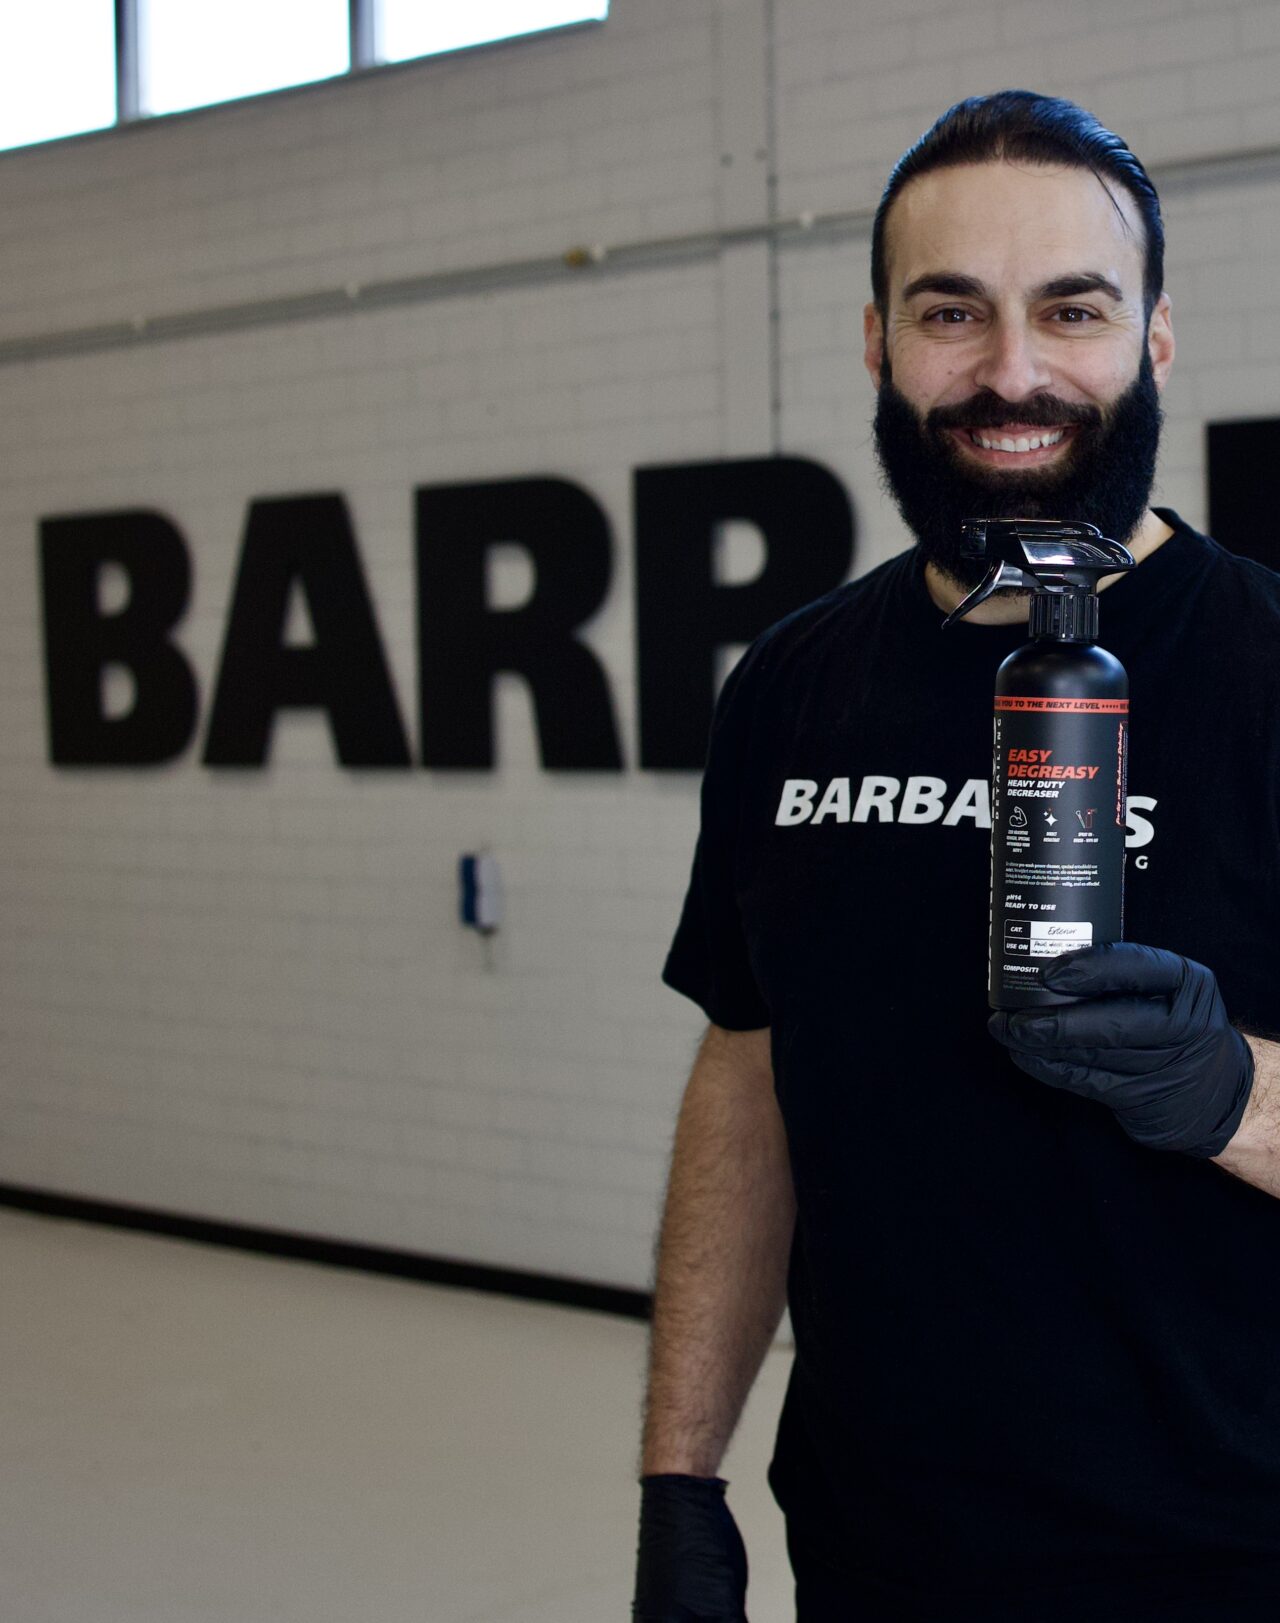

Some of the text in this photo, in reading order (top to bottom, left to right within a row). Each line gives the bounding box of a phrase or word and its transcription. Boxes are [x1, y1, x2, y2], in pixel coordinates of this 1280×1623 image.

[1008, 749, 1052, 763] EASY
[1007, 764, 1099, 779] DEGREASY
[1007, 779, 1065, 789] HEAVY DUTY
[1007, 789, 1059, 798] DEGREASER
[774, 775, 1159, 849] BARBAS
[1003, 964, 1039, 973] COMPOSITI
